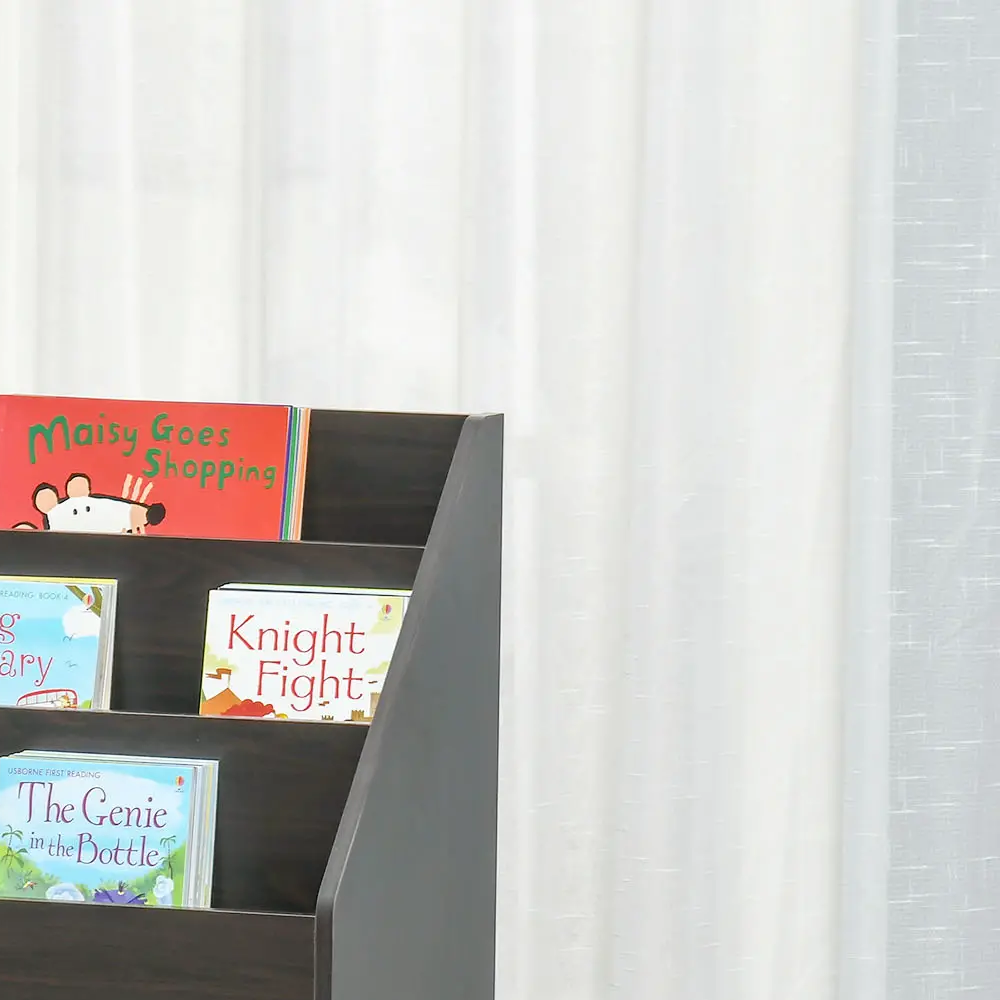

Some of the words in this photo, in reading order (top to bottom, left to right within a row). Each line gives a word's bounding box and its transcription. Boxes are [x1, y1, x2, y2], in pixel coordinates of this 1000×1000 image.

[28, 413, 138, 464] Maisy
[151, 412, 231, 447] Goes
[142, 448, 277, 490] Shopping
[0, 590, 34, 599] READING
[39, 592, 61, 601] BOOK
[228, 613, 365, 666] Knight
[257, 659, 363, 712] Fight
[7, 767, 44, 777] USBORNE
[45, 768, 65, 778] FIRST
[66, 769, 101, 779] READING
[17, 781, 75, 824] The
[81, 786, 168, 829] Genie
[29, 831, 45, 850] in
[48, 833, 75, 858] the
[76, 832, 160, 867] Bottle
